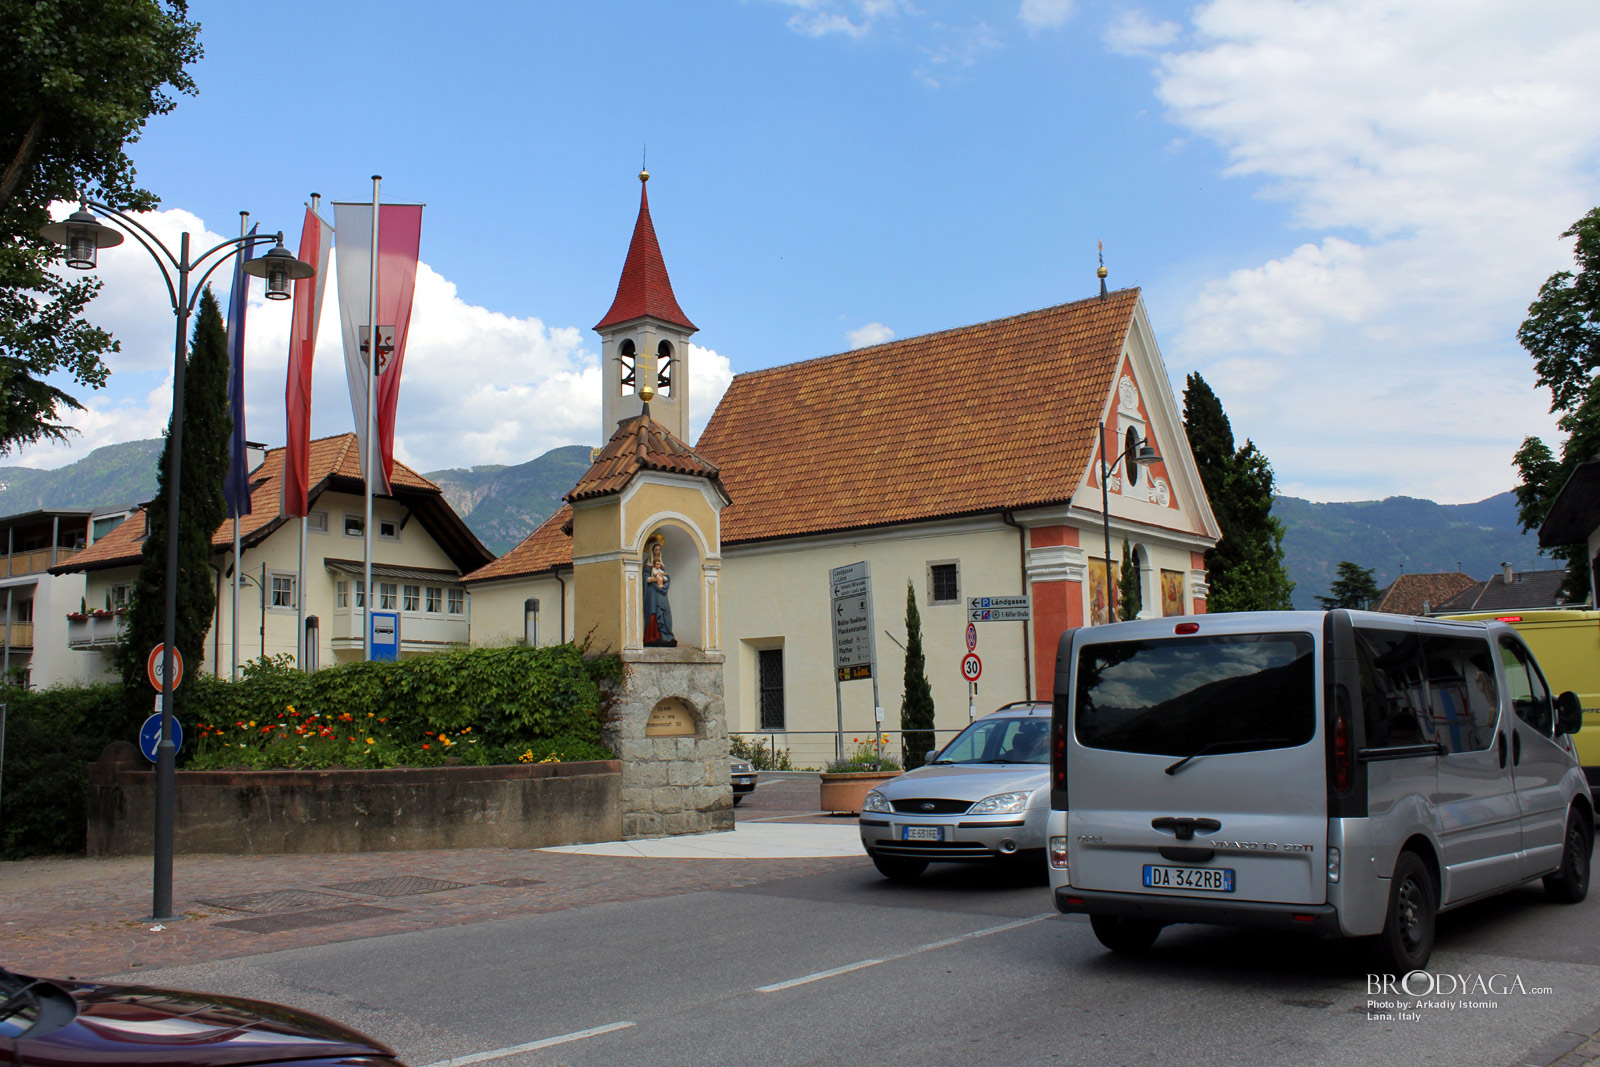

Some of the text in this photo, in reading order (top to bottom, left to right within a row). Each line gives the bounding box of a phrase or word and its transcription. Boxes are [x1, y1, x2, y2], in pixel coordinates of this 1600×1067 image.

[991, 598, 1027, 606] Ländgasse
[966, 660, 978, 674] 30
[1210, 839, 1258, 850] VIVARO
[1153, 868, 1222, 889] DA 342RB
